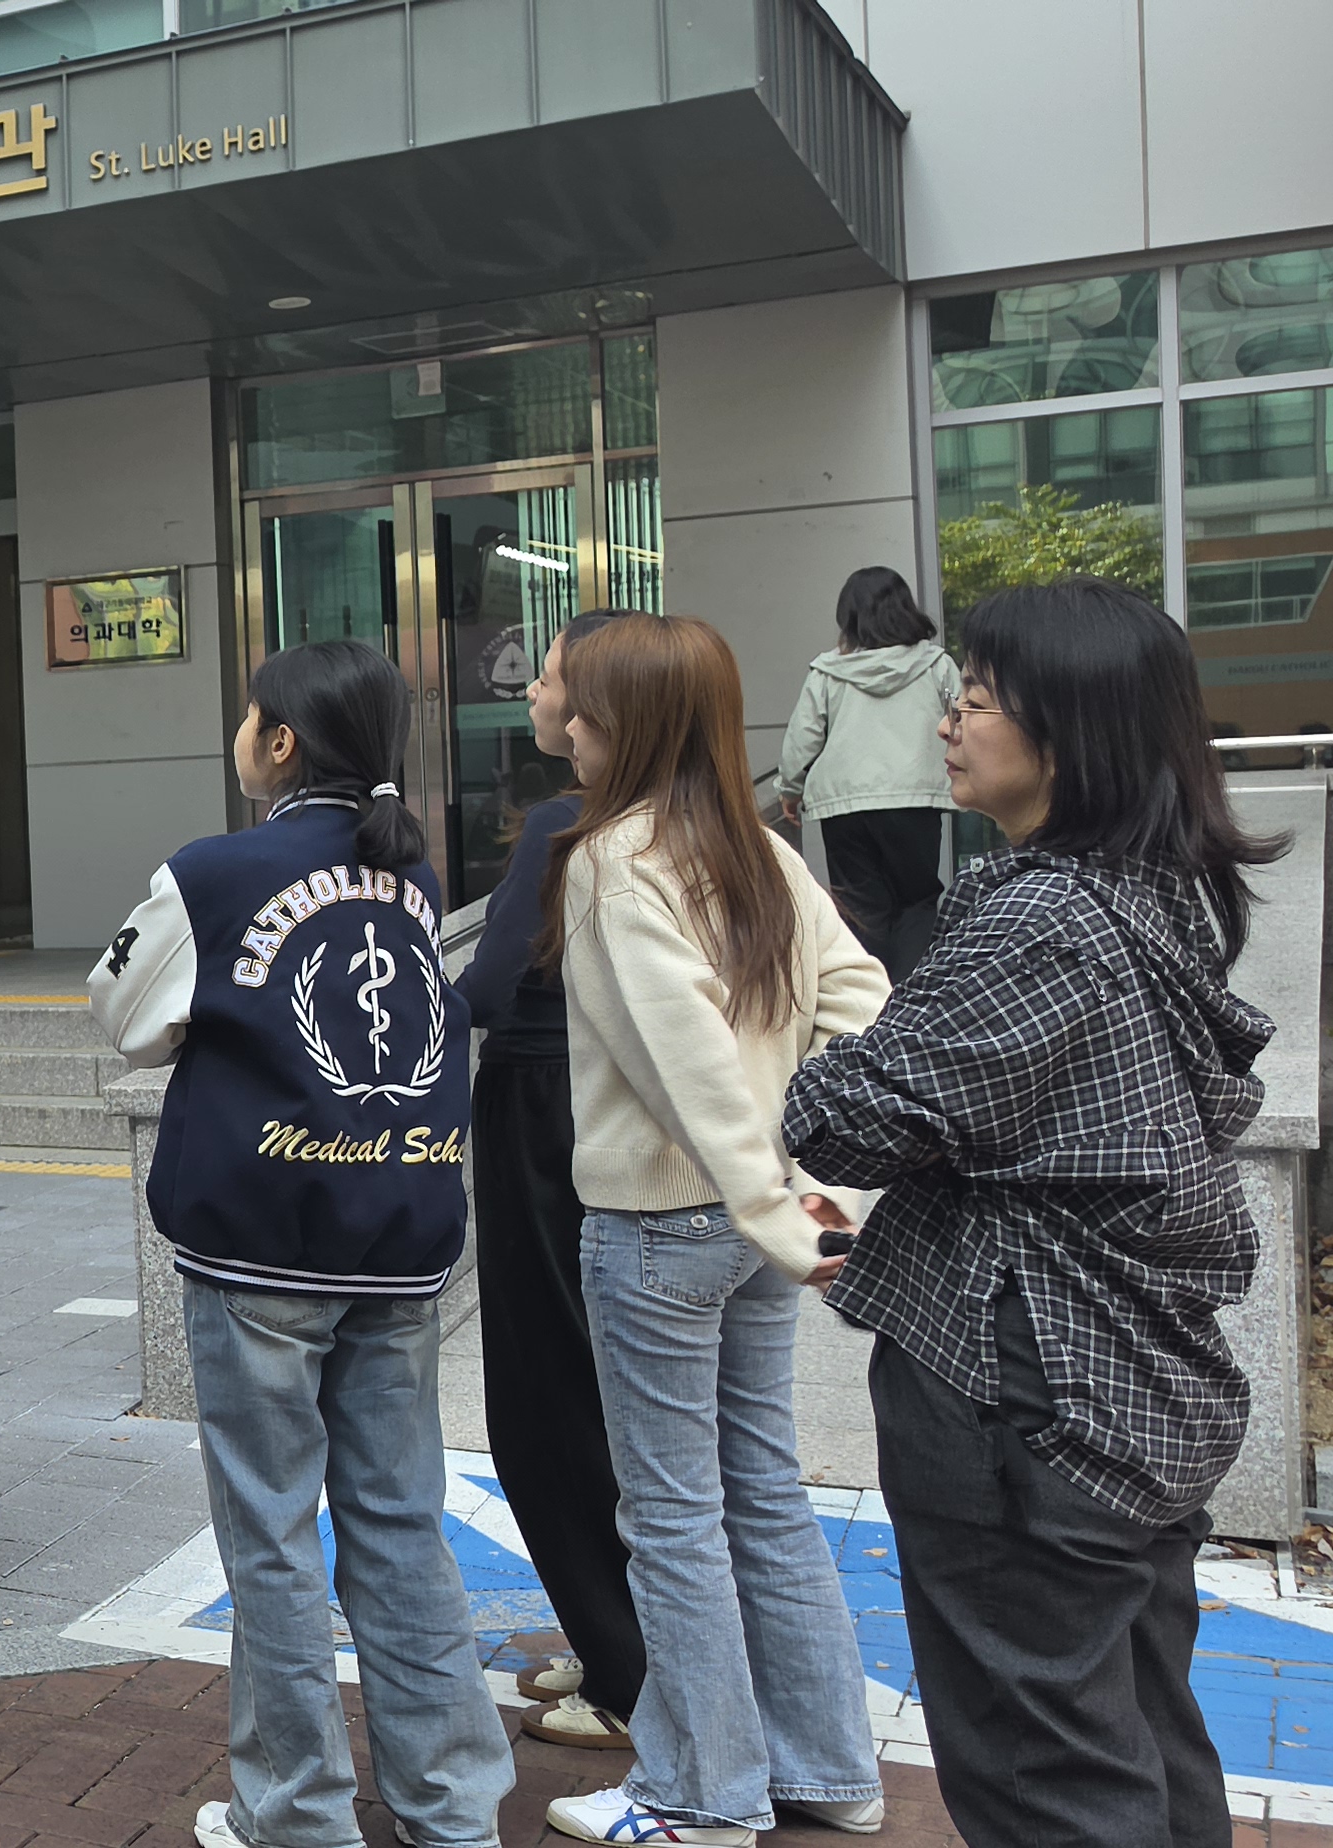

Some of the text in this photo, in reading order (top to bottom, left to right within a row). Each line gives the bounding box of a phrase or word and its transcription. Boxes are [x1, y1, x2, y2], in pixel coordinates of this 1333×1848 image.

[88, 113, 288, 180] St. Luke Hall
[70, 618, 162, 643] 의과대학
[232, 864, 397, 989] CATHOLIC
[258, 1120, 391, 1163] Medical
